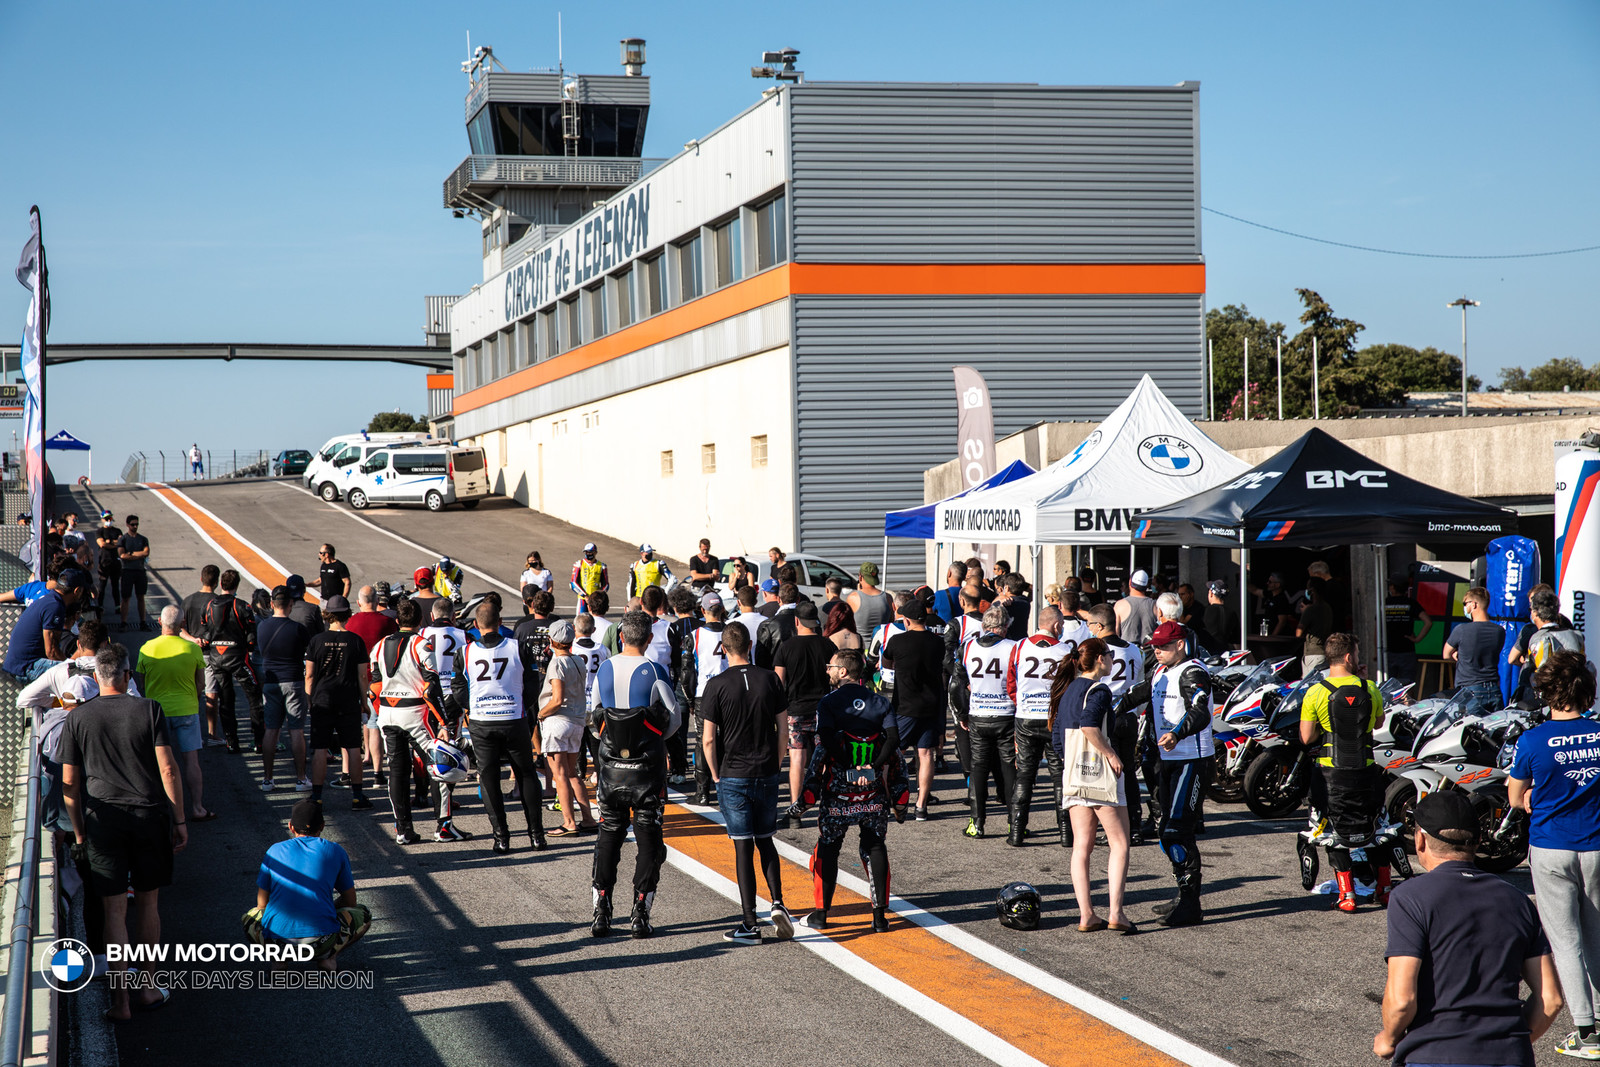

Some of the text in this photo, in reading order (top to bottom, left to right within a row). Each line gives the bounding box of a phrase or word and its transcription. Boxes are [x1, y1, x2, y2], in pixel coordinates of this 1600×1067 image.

[505, 183, 651, 322] CIRCUIT de LEDENON
[1143, 437, 1189, 450] BMW
[1222, 471, 1283, 490] BMC
[1306, 470, 1389, 489] BMC
[944, 509, 1021, 531] BMW MOTORRAD
[1428, 521, 1502, 532] bmc-moto.com
[475, 657, 509, 682] 27
[971, 656, 1003, 679] 24
[1024, 656, 1059, 679] 22
[1112, 658, 1135, 681] 21
